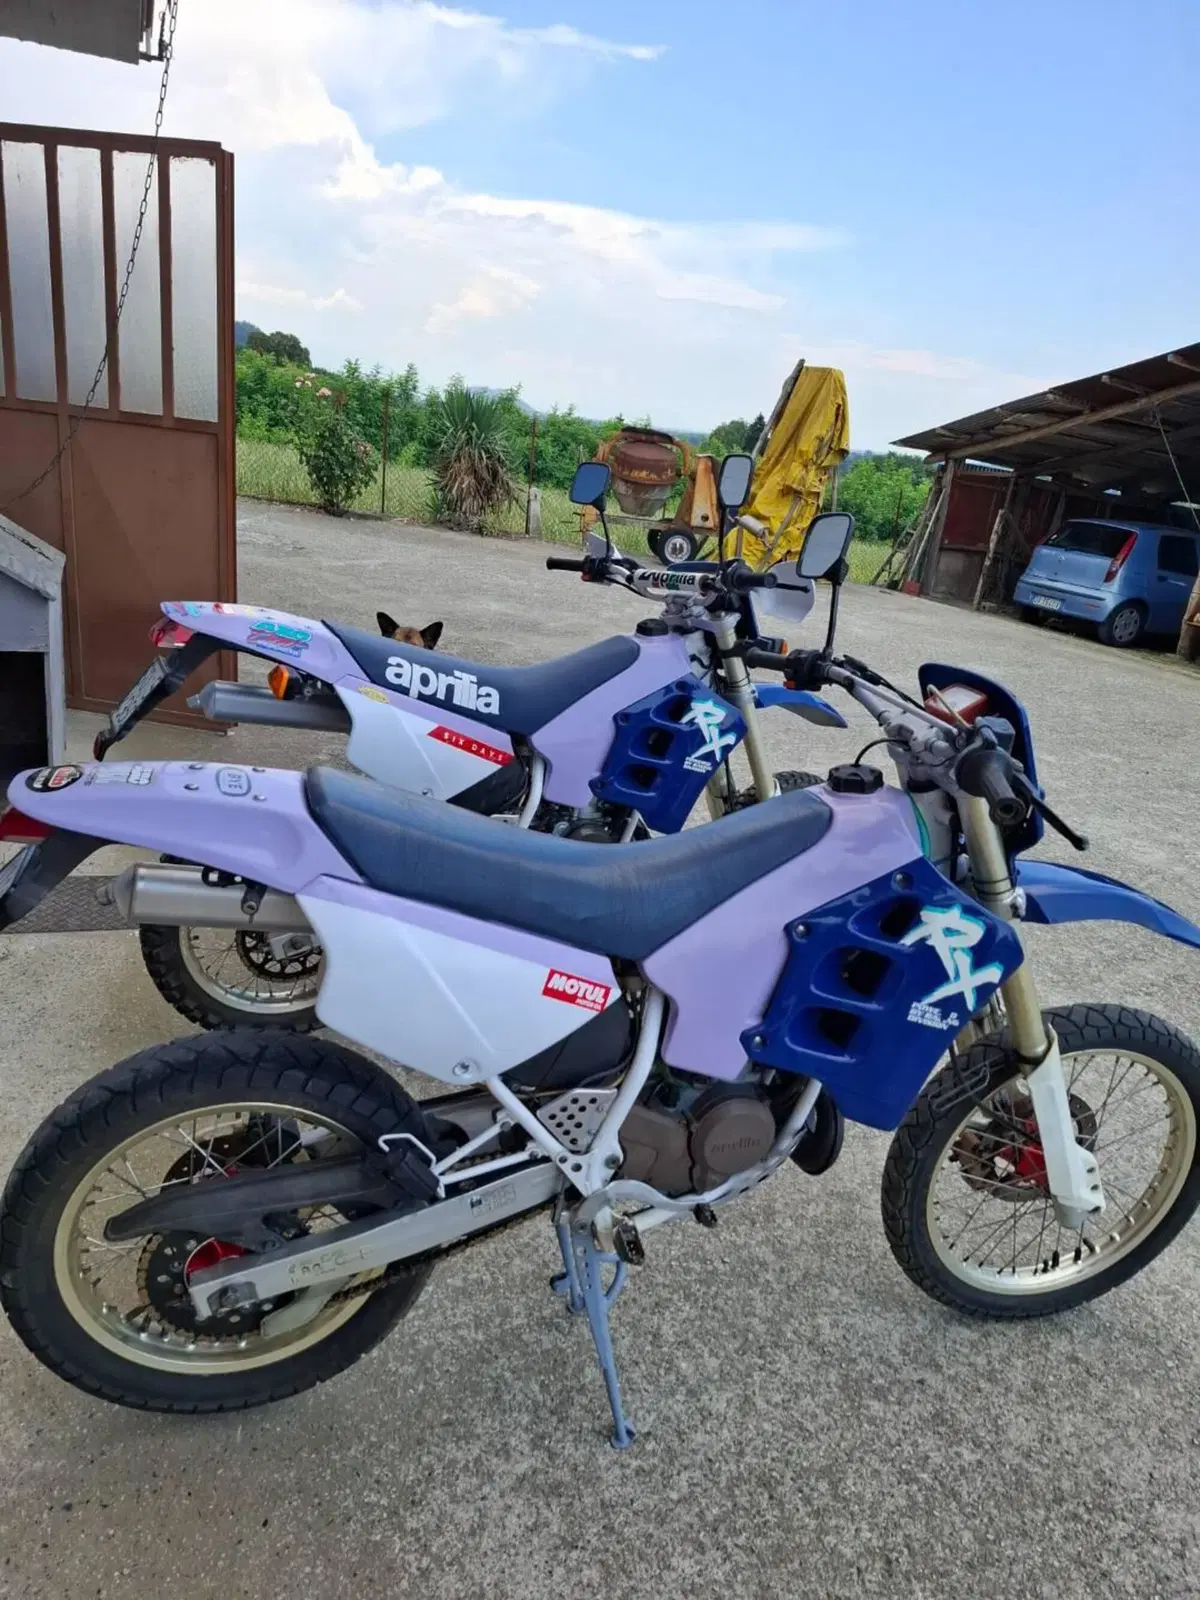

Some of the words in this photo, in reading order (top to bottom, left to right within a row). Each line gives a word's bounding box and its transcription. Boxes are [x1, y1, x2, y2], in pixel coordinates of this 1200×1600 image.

[385, 656, 500, 715] aprilia
[443, 731, 464, 747] SIX
[471, 743, 504, 762] DAYS
[547, 973, 606, 1004] MOTUL
